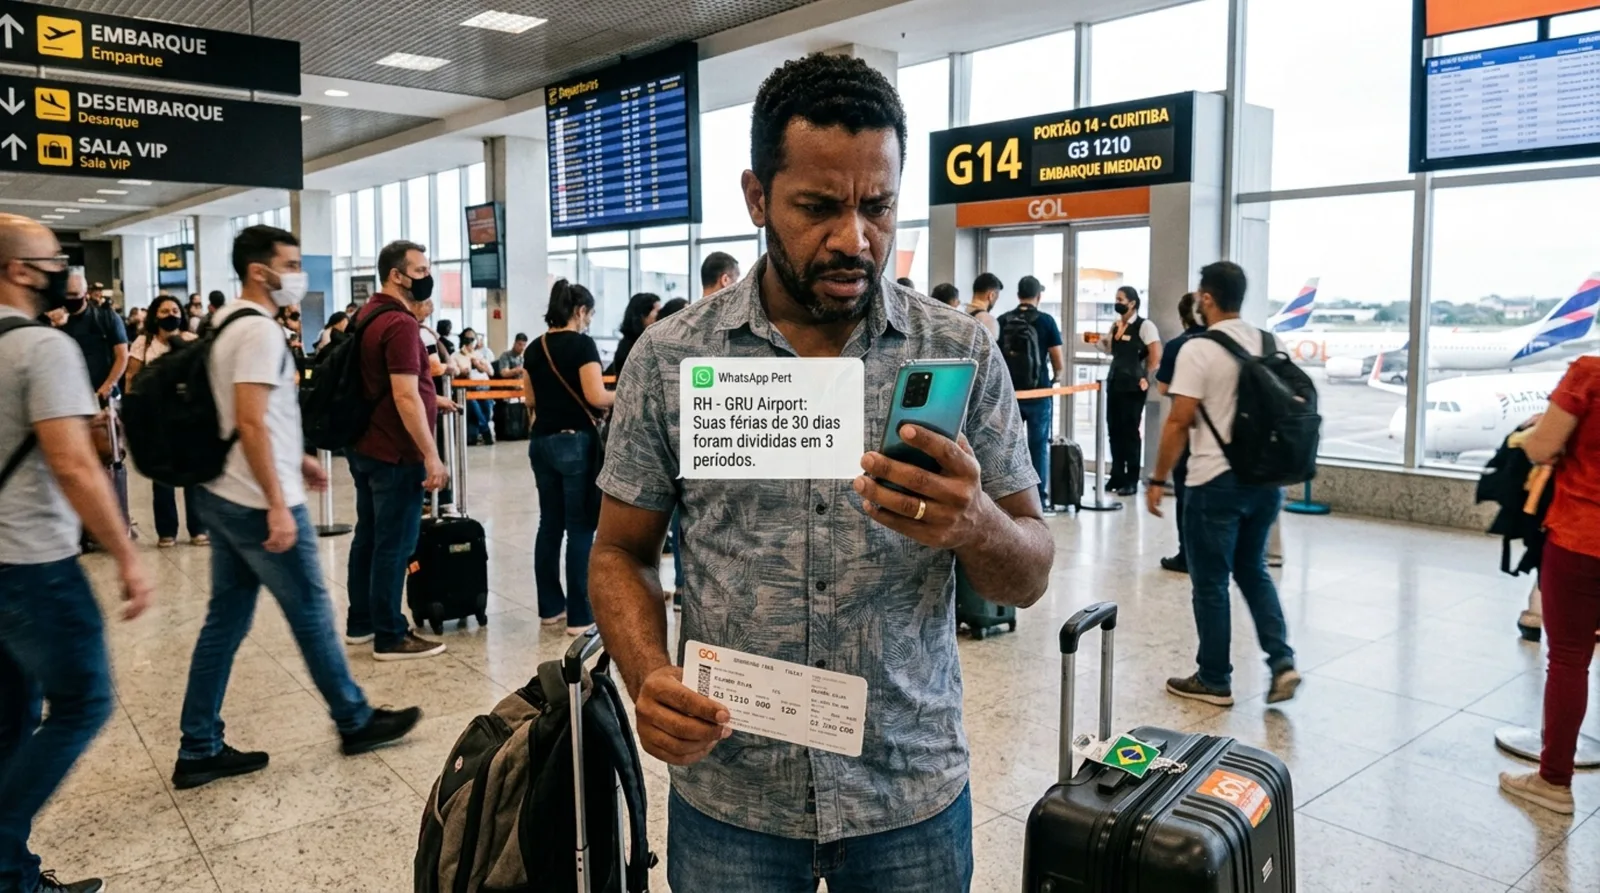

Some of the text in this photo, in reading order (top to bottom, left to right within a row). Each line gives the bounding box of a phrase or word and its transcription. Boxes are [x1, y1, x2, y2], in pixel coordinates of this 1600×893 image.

[91, 24, 207, 55] EMBARQUE
[91, 46, 163, 67] Empartue
[77, 92, 224, 122] DESEMBARQUE
[78, 111, 139, 129] Desarque
[1033, 119, 1081, 140] PORTÃO
[1084, 117, 1099, 133] 14
[1109, 107, 1169, 130] CURITIBA
[79, 136, 168, 159] SALA VIP
[1068, 135, 1131, 159] G3 1210
[946, 137, 1022, 186] G14
[1039, 155, 1162, 182] EMBARQUE IMEDIATO
[1027, 198, 1067, 220] GOL
[1510, 390, 1548, 403] LATA
[698, 648, 720, 663] GOL
[729, 694, 750, 705] 1210
[1211, 775, 1251, 801] GOL
